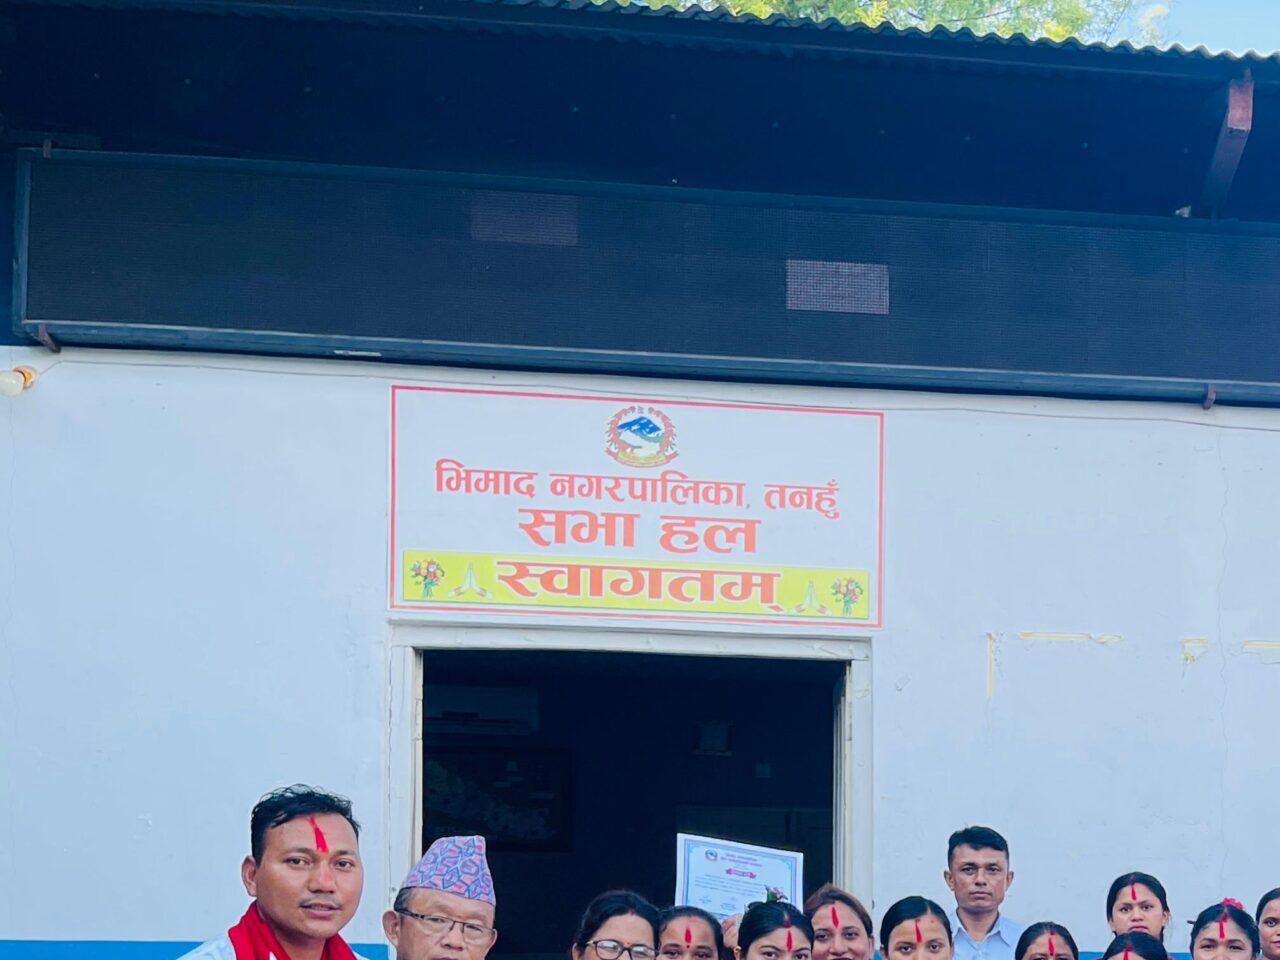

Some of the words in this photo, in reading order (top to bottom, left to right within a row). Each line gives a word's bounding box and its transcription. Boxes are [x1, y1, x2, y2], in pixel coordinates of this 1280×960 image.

[436, 458, 538, 497] भिमाद
[548, 470, 752, 510] नगरपालिका,
[764, 478, 840, 519] तनहुँ
[518, 508, 640, 547] सभा
[659, 515, 762, 553] हल
[495, 560, 786, 613] स्वागतम्
